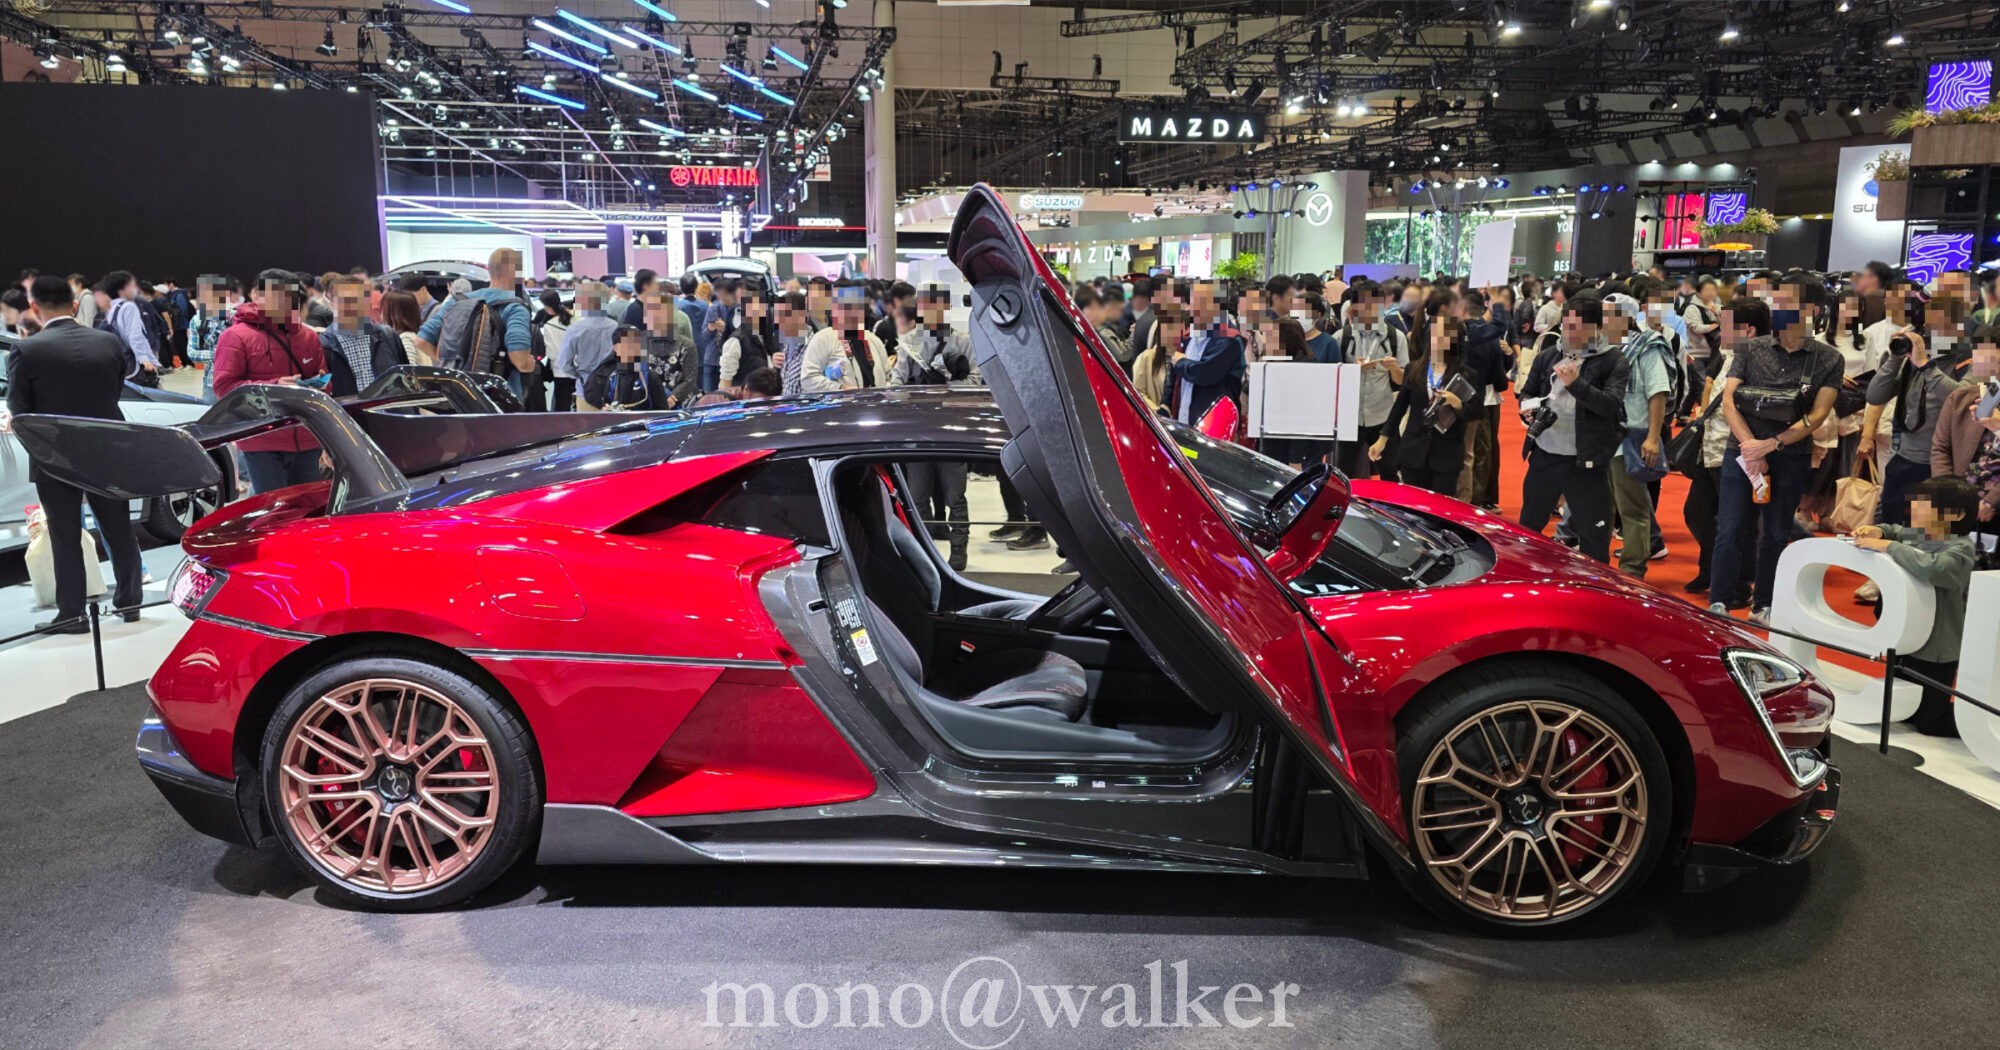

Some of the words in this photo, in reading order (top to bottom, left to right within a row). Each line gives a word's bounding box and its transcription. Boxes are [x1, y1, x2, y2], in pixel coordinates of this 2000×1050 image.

[1131, 117, 1254, 138] MAZDA
[690, 167, 759, 186] YAMAHA
[1035, 198, 1080, 206] SUZUKI
[1056, 244, 1131, 263] MAZDA
[1554, 260, 1570, 271] BES
